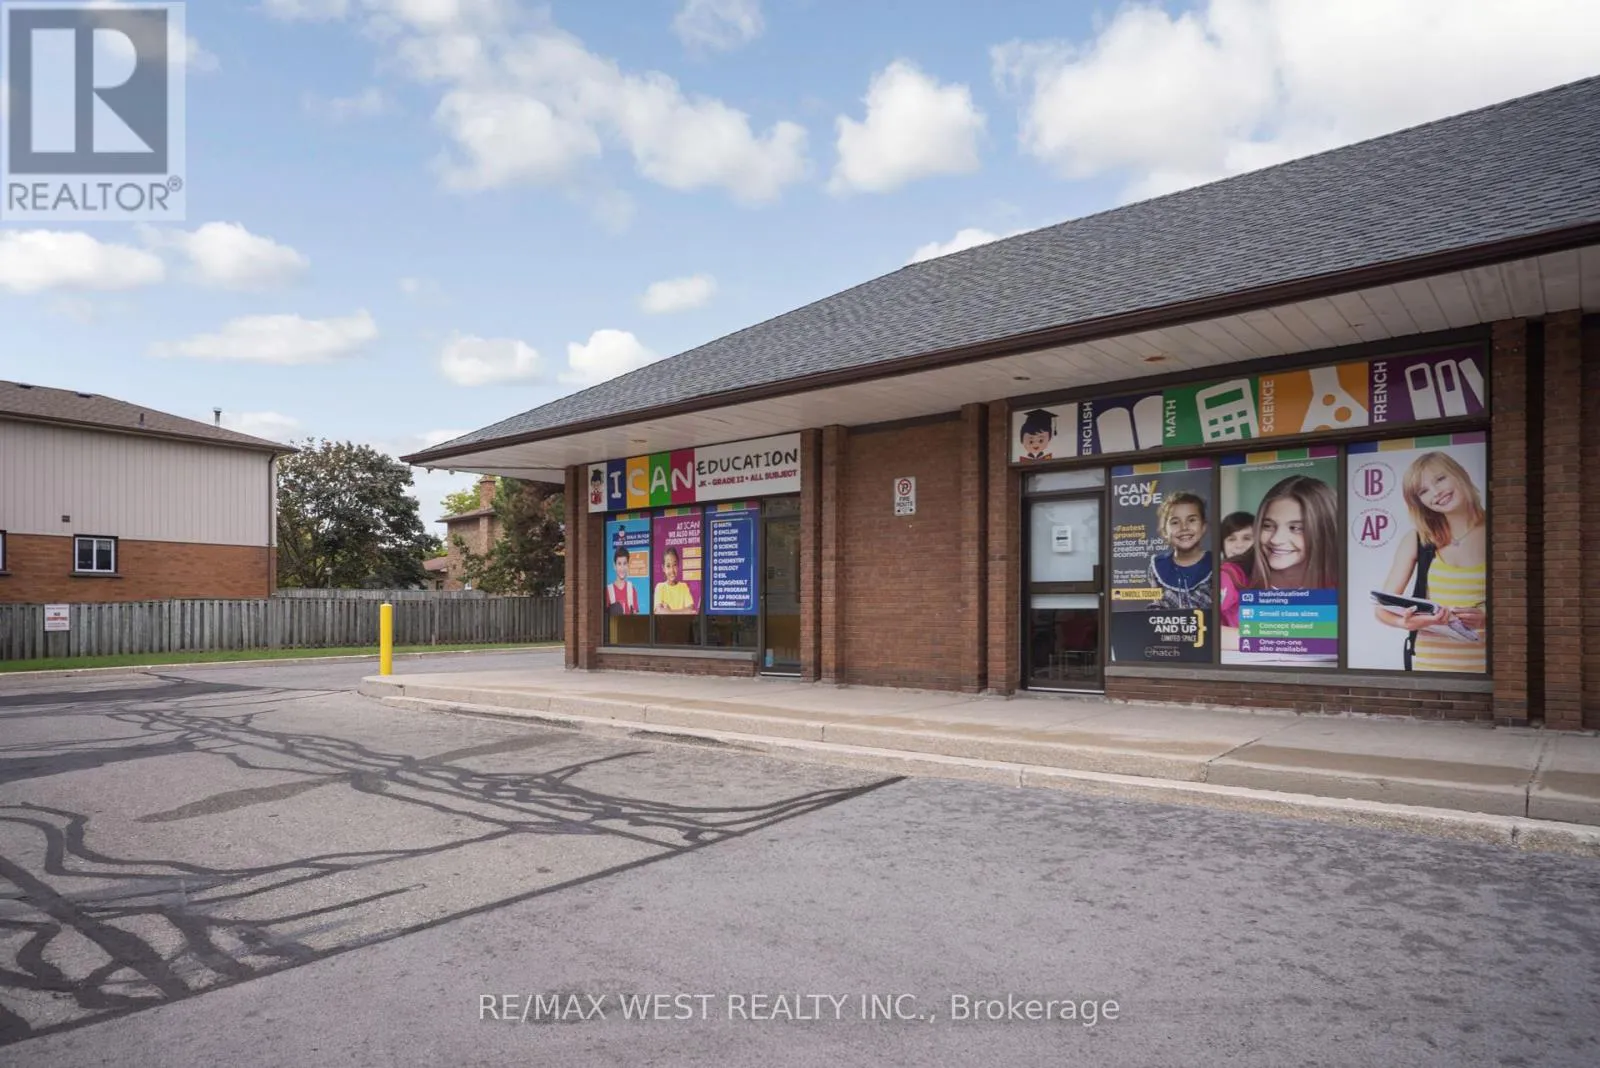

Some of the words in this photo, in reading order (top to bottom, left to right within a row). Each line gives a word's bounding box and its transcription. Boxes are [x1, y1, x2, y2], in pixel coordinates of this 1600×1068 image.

[1374, 361, 1387, 424] FRENCH
[1262, 379, 1274, 433] SCIENCE
[1165, 399, 1177, 438] MATH
[1082, 400, 1093, 456] ENGLISH
[696, 448, 799, 476] EDUCATION
[712, 476, 735, 486] GRADE
[750, 474, 763, 482] ALL
[764, 469, 798, 481] SUBJECT
[1365, 469, 1383, 496] IB
[1119, 492, 1162, 506] CODE
[676, 522, 683, 530] AT
[676, 530, 689, 538] ALSO
[689, 529, 700, 537] HELP
[1361, 515, 1388, 541] AP
[665, 538, 688, 546] STUDENTS
[1150, 538, 1163, 547] job
[1258, 597, 1289, 605] learning
[1148, 616, 1187, 625] GRADE
[1190, 616, 1197, 624] 3
[1154, 625, 1179, 633] AND
[1181, 624, 1198, 633] UP
